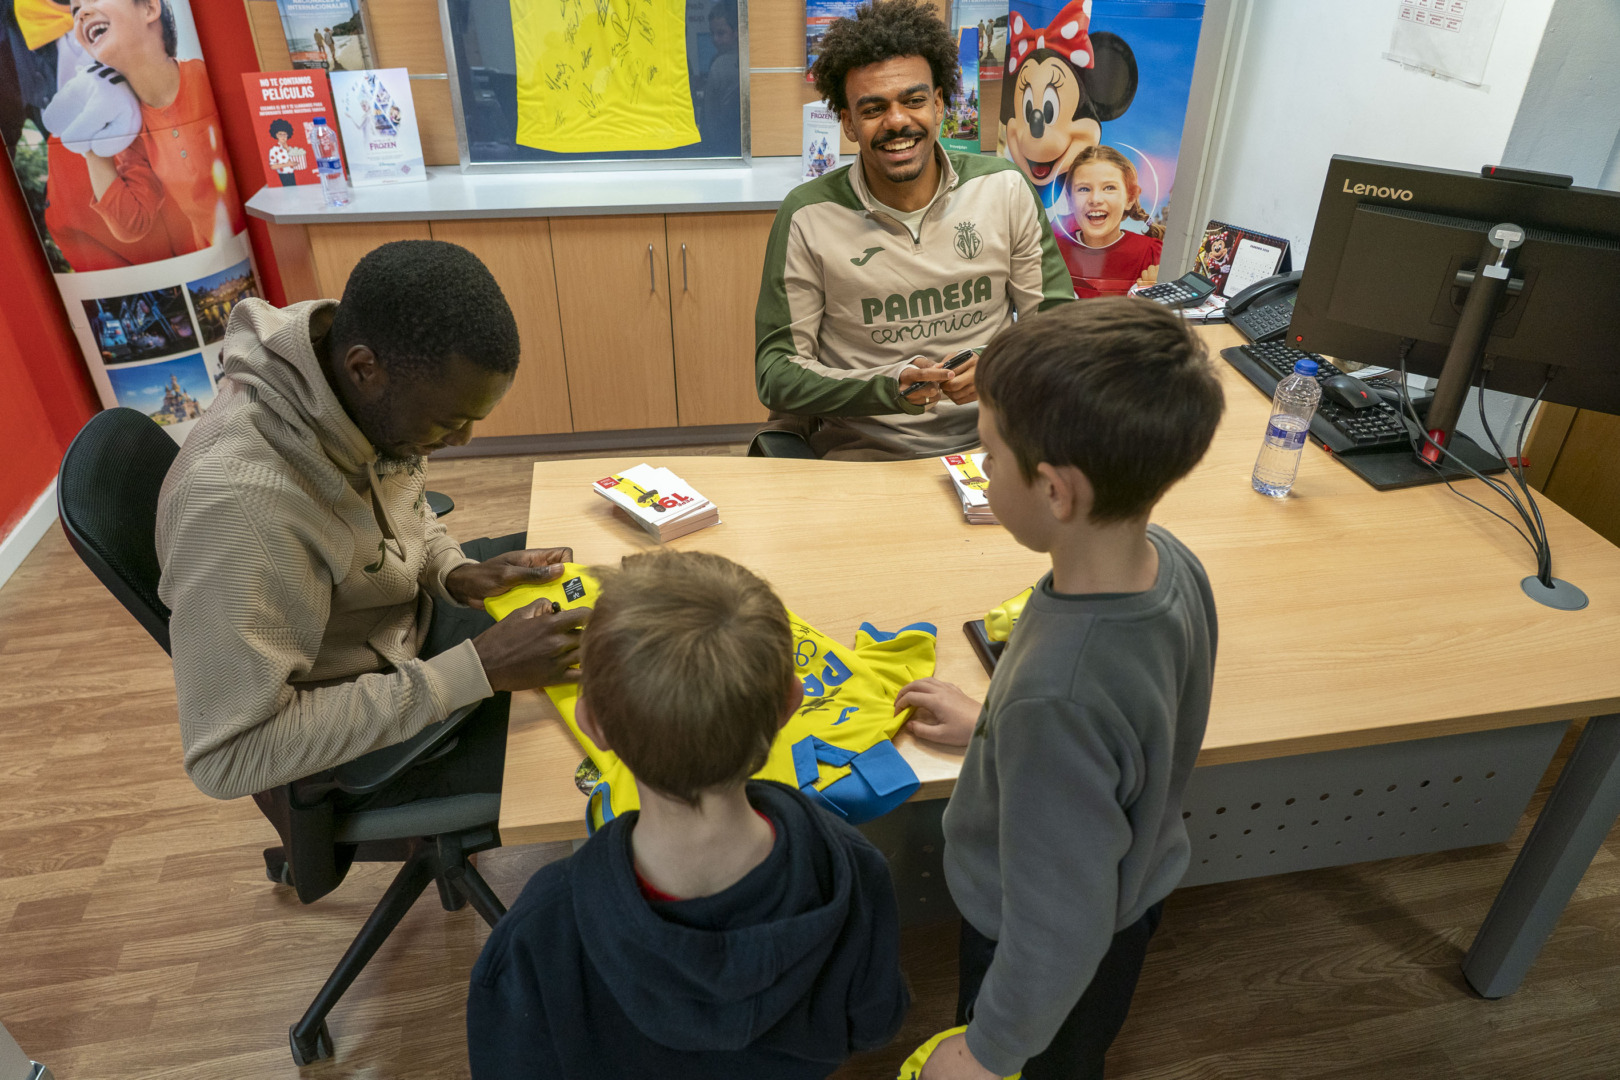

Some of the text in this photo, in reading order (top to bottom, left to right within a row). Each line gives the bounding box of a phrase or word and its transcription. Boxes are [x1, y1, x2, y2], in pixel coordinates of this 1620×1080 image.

[287, 2, 349, 10] INTERNACIONALES
[259, 76, 312, 87] NO TE CONTAMOS
[262, 85, 314, 101] PELÍCULAS
[811, 112, 833, 120] FROZEN
[369, 141, 397, 151] FROZEN
[1342, 178, 1413, 201] Lenovo
[861, 275, 992, 325] PAMESA
[871, 310, 988, 344] cerámica
[658, 492, 691, 509] 19
